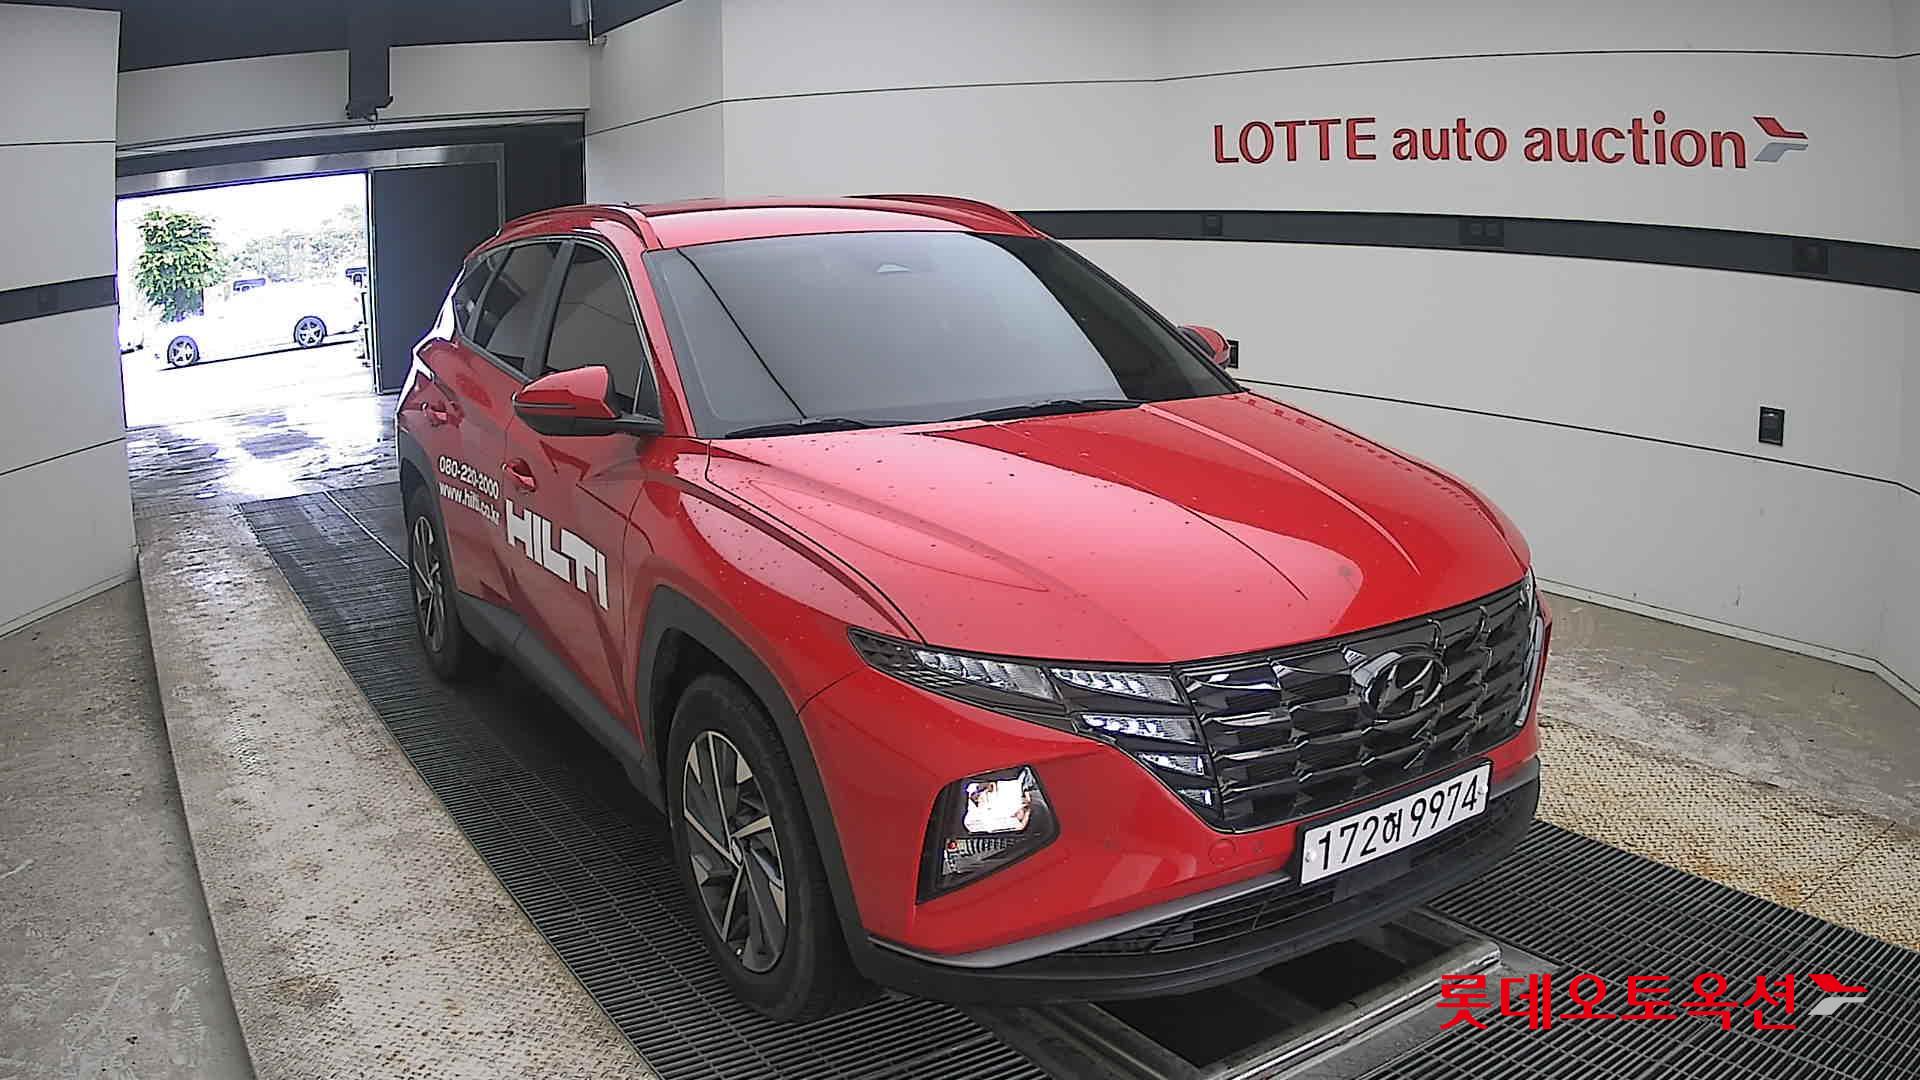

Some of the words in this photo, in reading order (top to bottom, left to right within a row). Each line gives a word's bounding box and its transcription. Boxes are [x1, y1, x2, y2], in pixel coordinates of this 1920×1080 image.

[1214, 117, 1376, 163] LOTTE
[1391, 117, 1508, 161] auto
[1523, 110, 1747, 168] auction
[439, 455, 499, 499] 080-220-2000
[505, 499, 609, 612] HILTI
